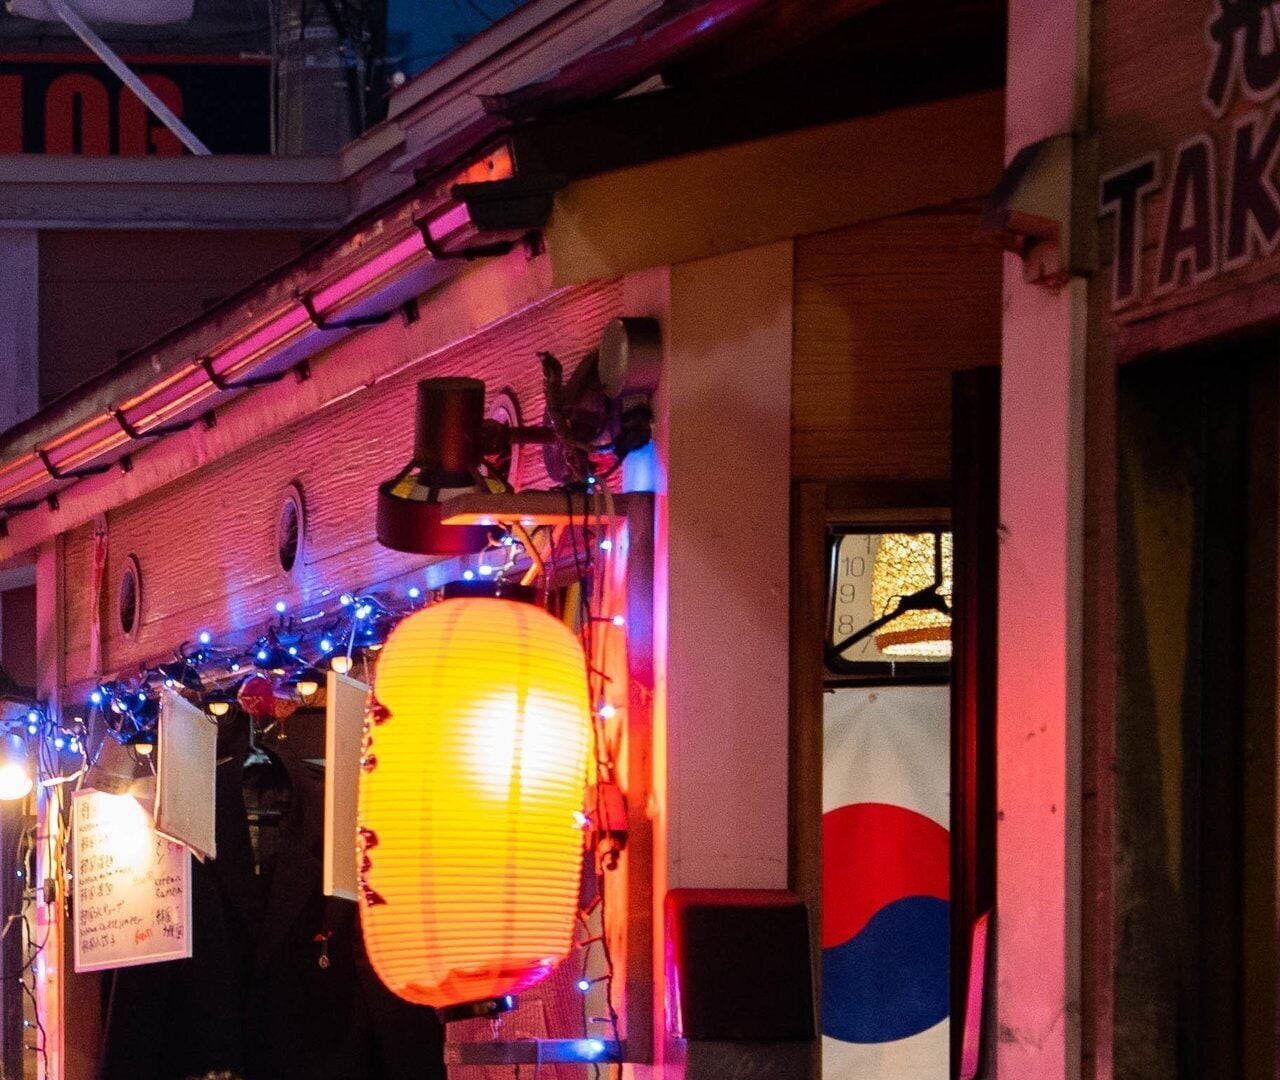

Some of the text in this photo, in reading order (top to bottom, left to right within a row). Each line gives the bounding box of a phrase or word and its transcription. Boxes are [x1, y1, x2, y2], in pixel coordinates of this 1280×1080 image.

[841, 556, 866, 578] 10
[840, 583, 856, 604] 9
[838, 614, 854, 635] 8
